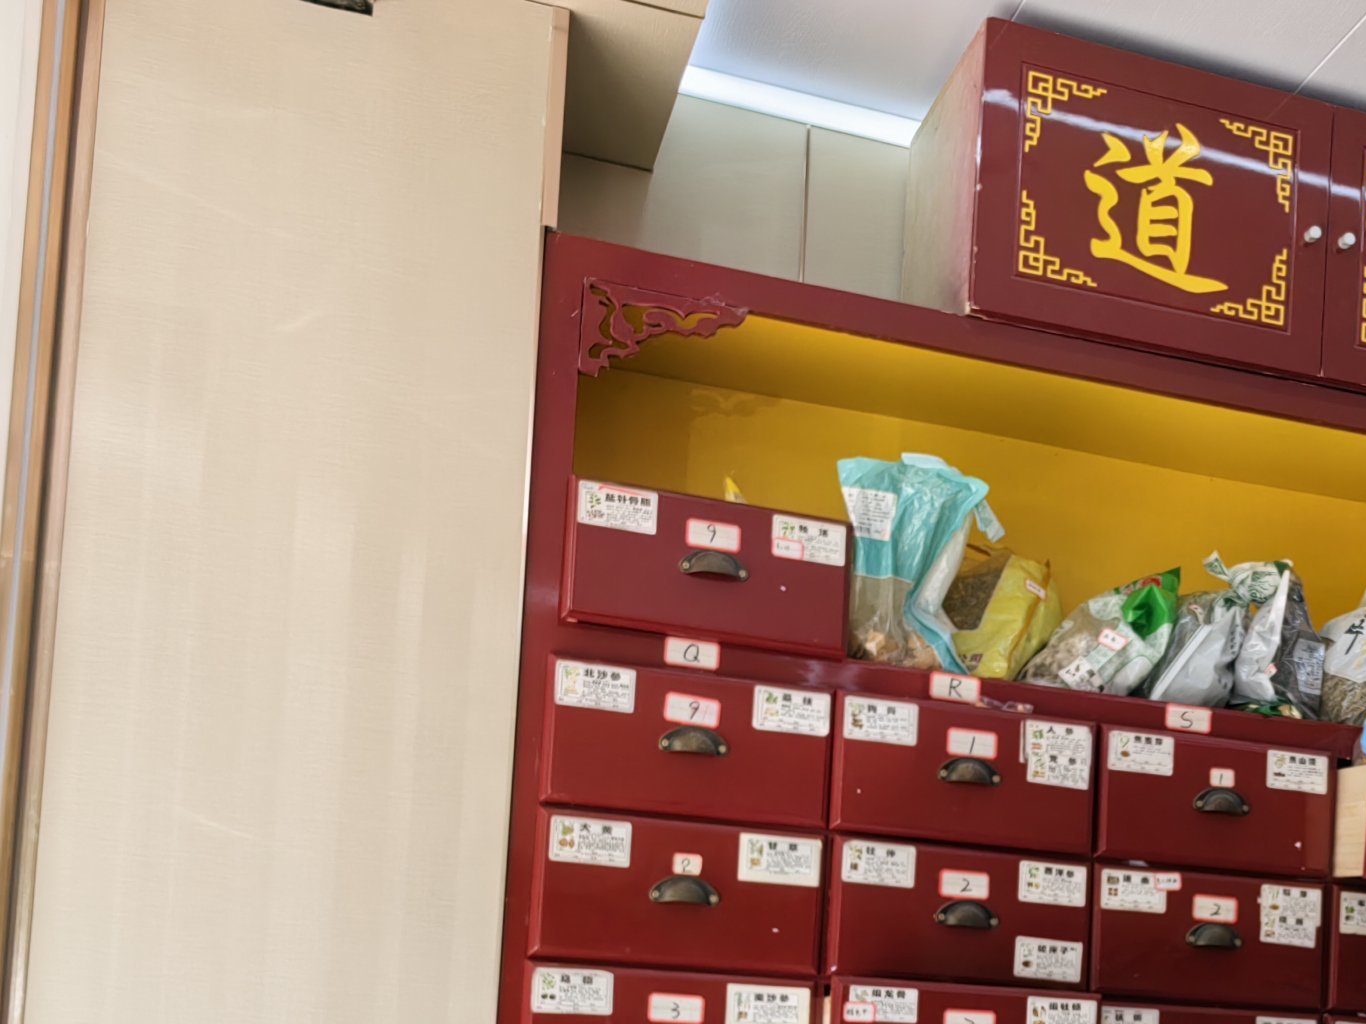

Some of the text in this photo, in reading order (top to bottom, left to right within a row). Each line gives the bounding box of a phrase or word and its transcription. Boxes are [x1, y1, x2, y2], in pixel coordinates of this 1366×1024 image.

[706, 523, 717, 543] 9
[683, 643, 700, 663] Q
[947, 677, 963, 698] R
[1180, 711, 1194, 729] S
[960, 877, 972, 893] 2
[1209, 903, 1221, 917] 2
[670, 1001, 681, 1020] 3
